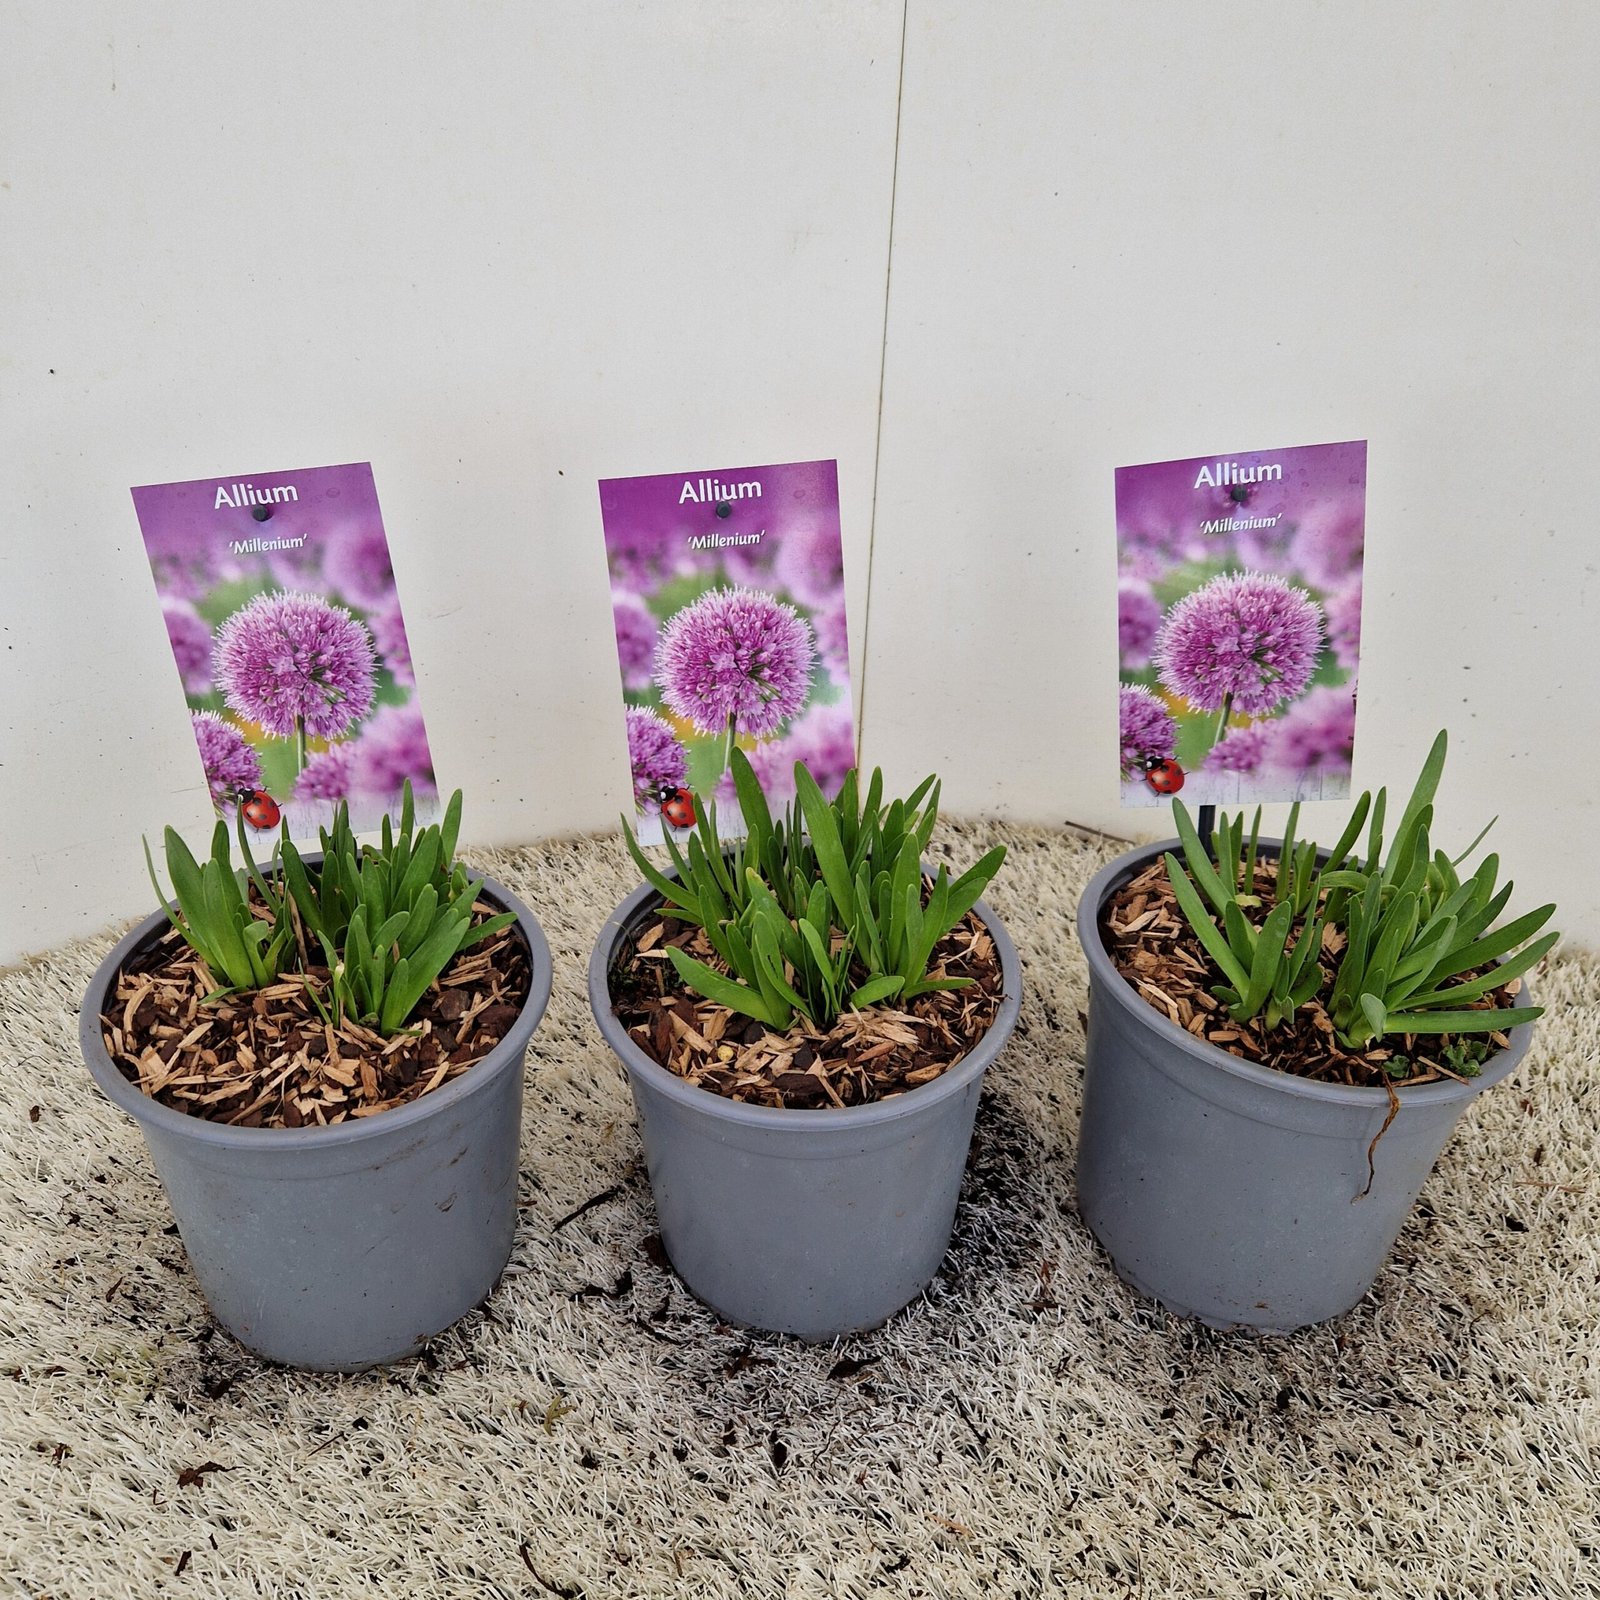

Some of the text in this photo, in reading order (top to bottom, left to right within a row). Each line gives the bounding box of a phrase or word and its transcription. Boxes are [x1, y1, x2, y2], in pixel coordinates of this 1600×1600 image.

[1194, 462, 1282, 489] Allium
[214, 483, 299, 509] Allium
[679, 478, 762, 504] Allium
